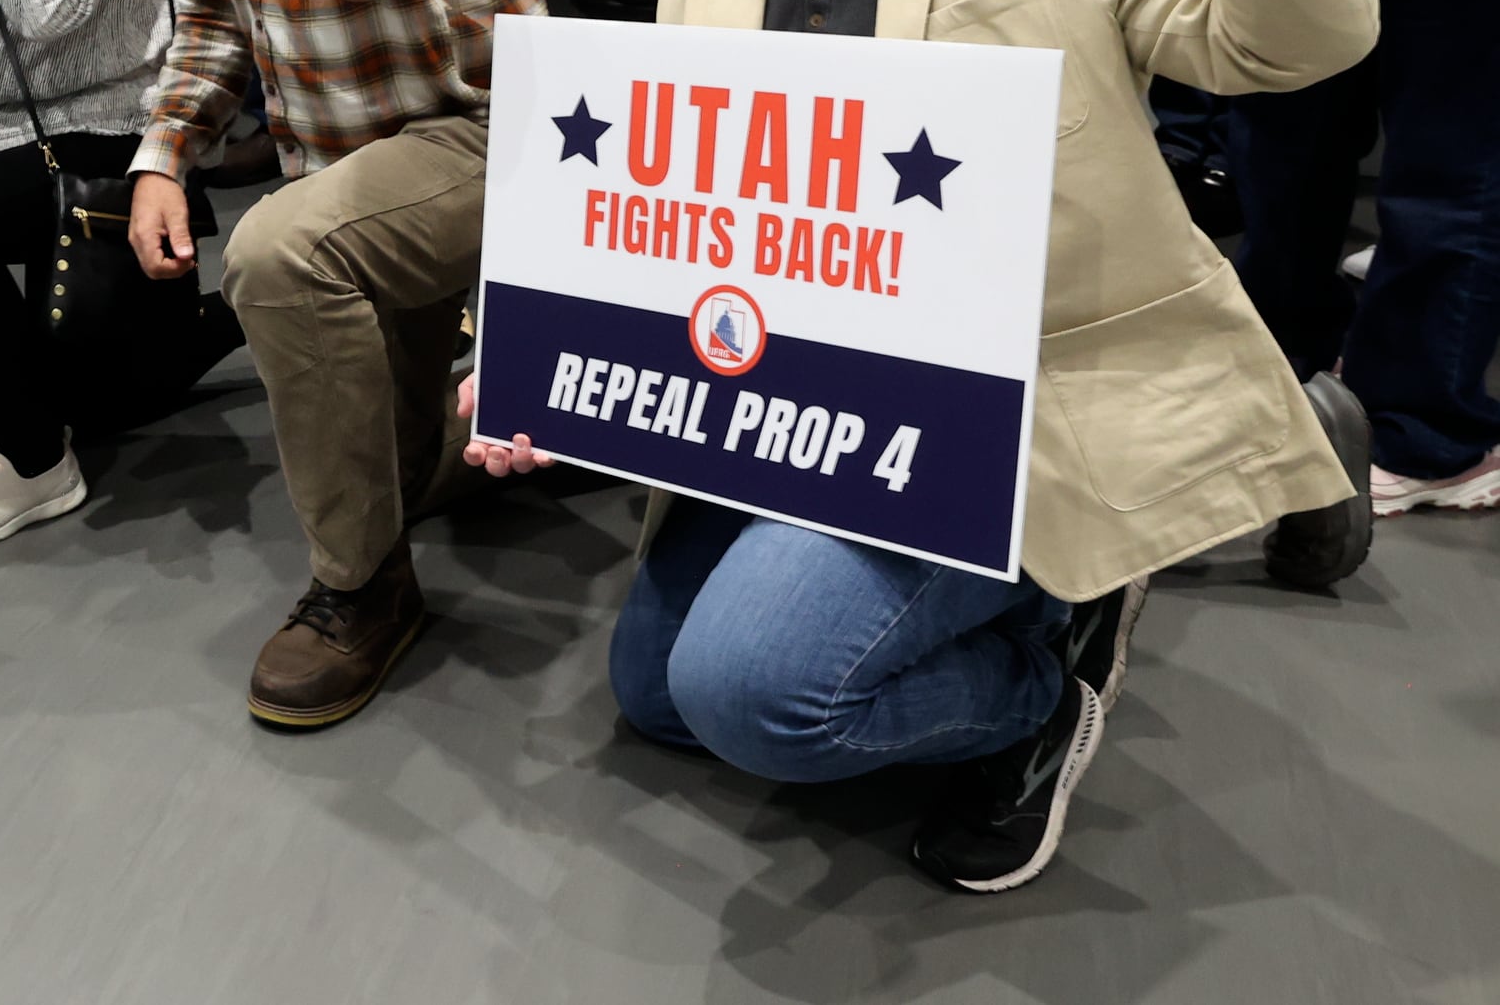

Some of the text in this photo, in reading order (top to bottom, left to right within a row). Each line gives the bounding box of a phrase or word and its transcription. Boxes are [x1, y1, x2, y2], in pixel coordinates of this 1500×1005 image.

[626, 80, 865, 213] UTAH
[583, 189, 905, 298] FIGHTS BACK!
[547, 351, 922, 492] REPEAL PROP 4
